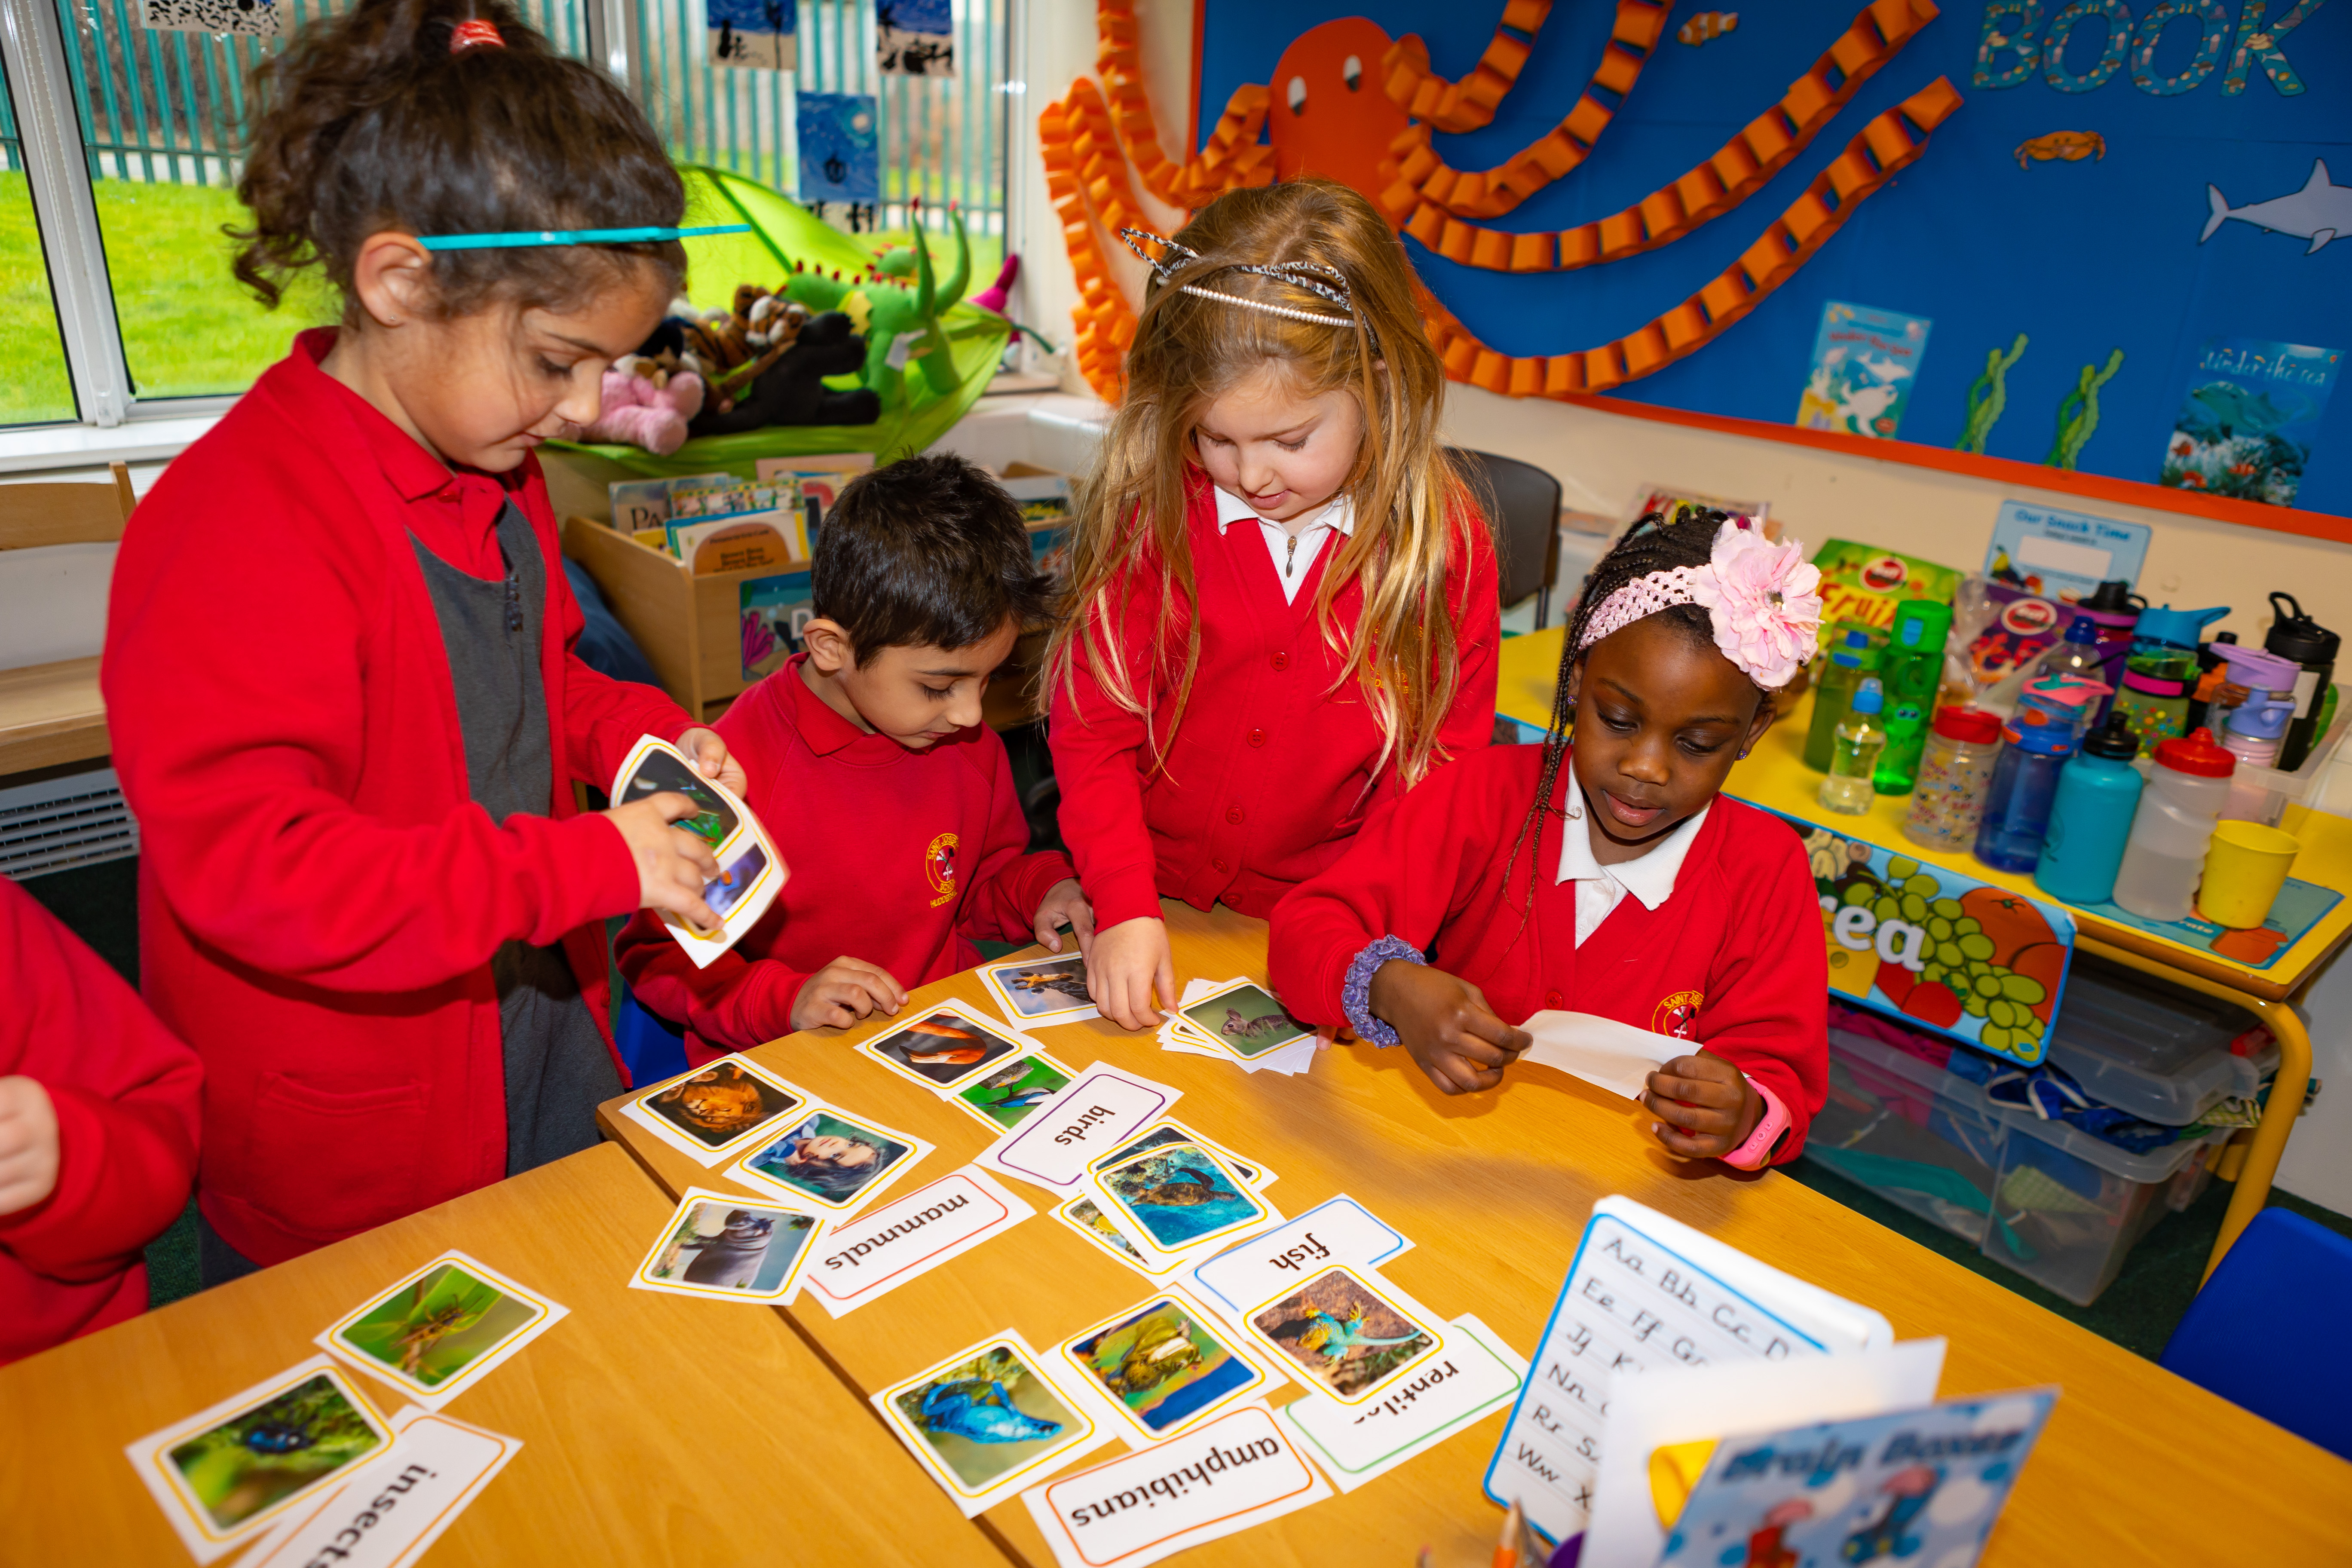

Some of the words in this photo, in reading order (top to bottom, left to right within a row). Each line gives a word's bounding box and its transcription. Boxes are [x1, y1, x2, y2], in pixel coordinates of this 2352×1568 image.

[1970, 0, 2327, 97] BOOK
[2015, 510, 2041, 524] Our
[2096, 523, 2131, 542] Time
[928, 839, 940, 860] SAINT
[1664, 994, 1689, 1009] SAINT
[1054, 1105, 1116, 1145] birds
[825, 1194, 970, 1270] mammals
[1269, 1233, 1330, 1271] fish
[1583, 1277, 1615, 1312] Ee
[1632, 1310, 1663, 1342] Ff
[1604, 1238, 1644, 1276] Aa
[1660, 1269, 1697, 1308] Bb
[1712, 1304, 1751, 1344] Cc
[1548, 1363, 1586, 1403] Nn
[1532, 1404, 1563, 1433] Rr
[1071, 1436, 1280, 1527] amphibians
[1517, 1442, 1560, 1482] Ww
